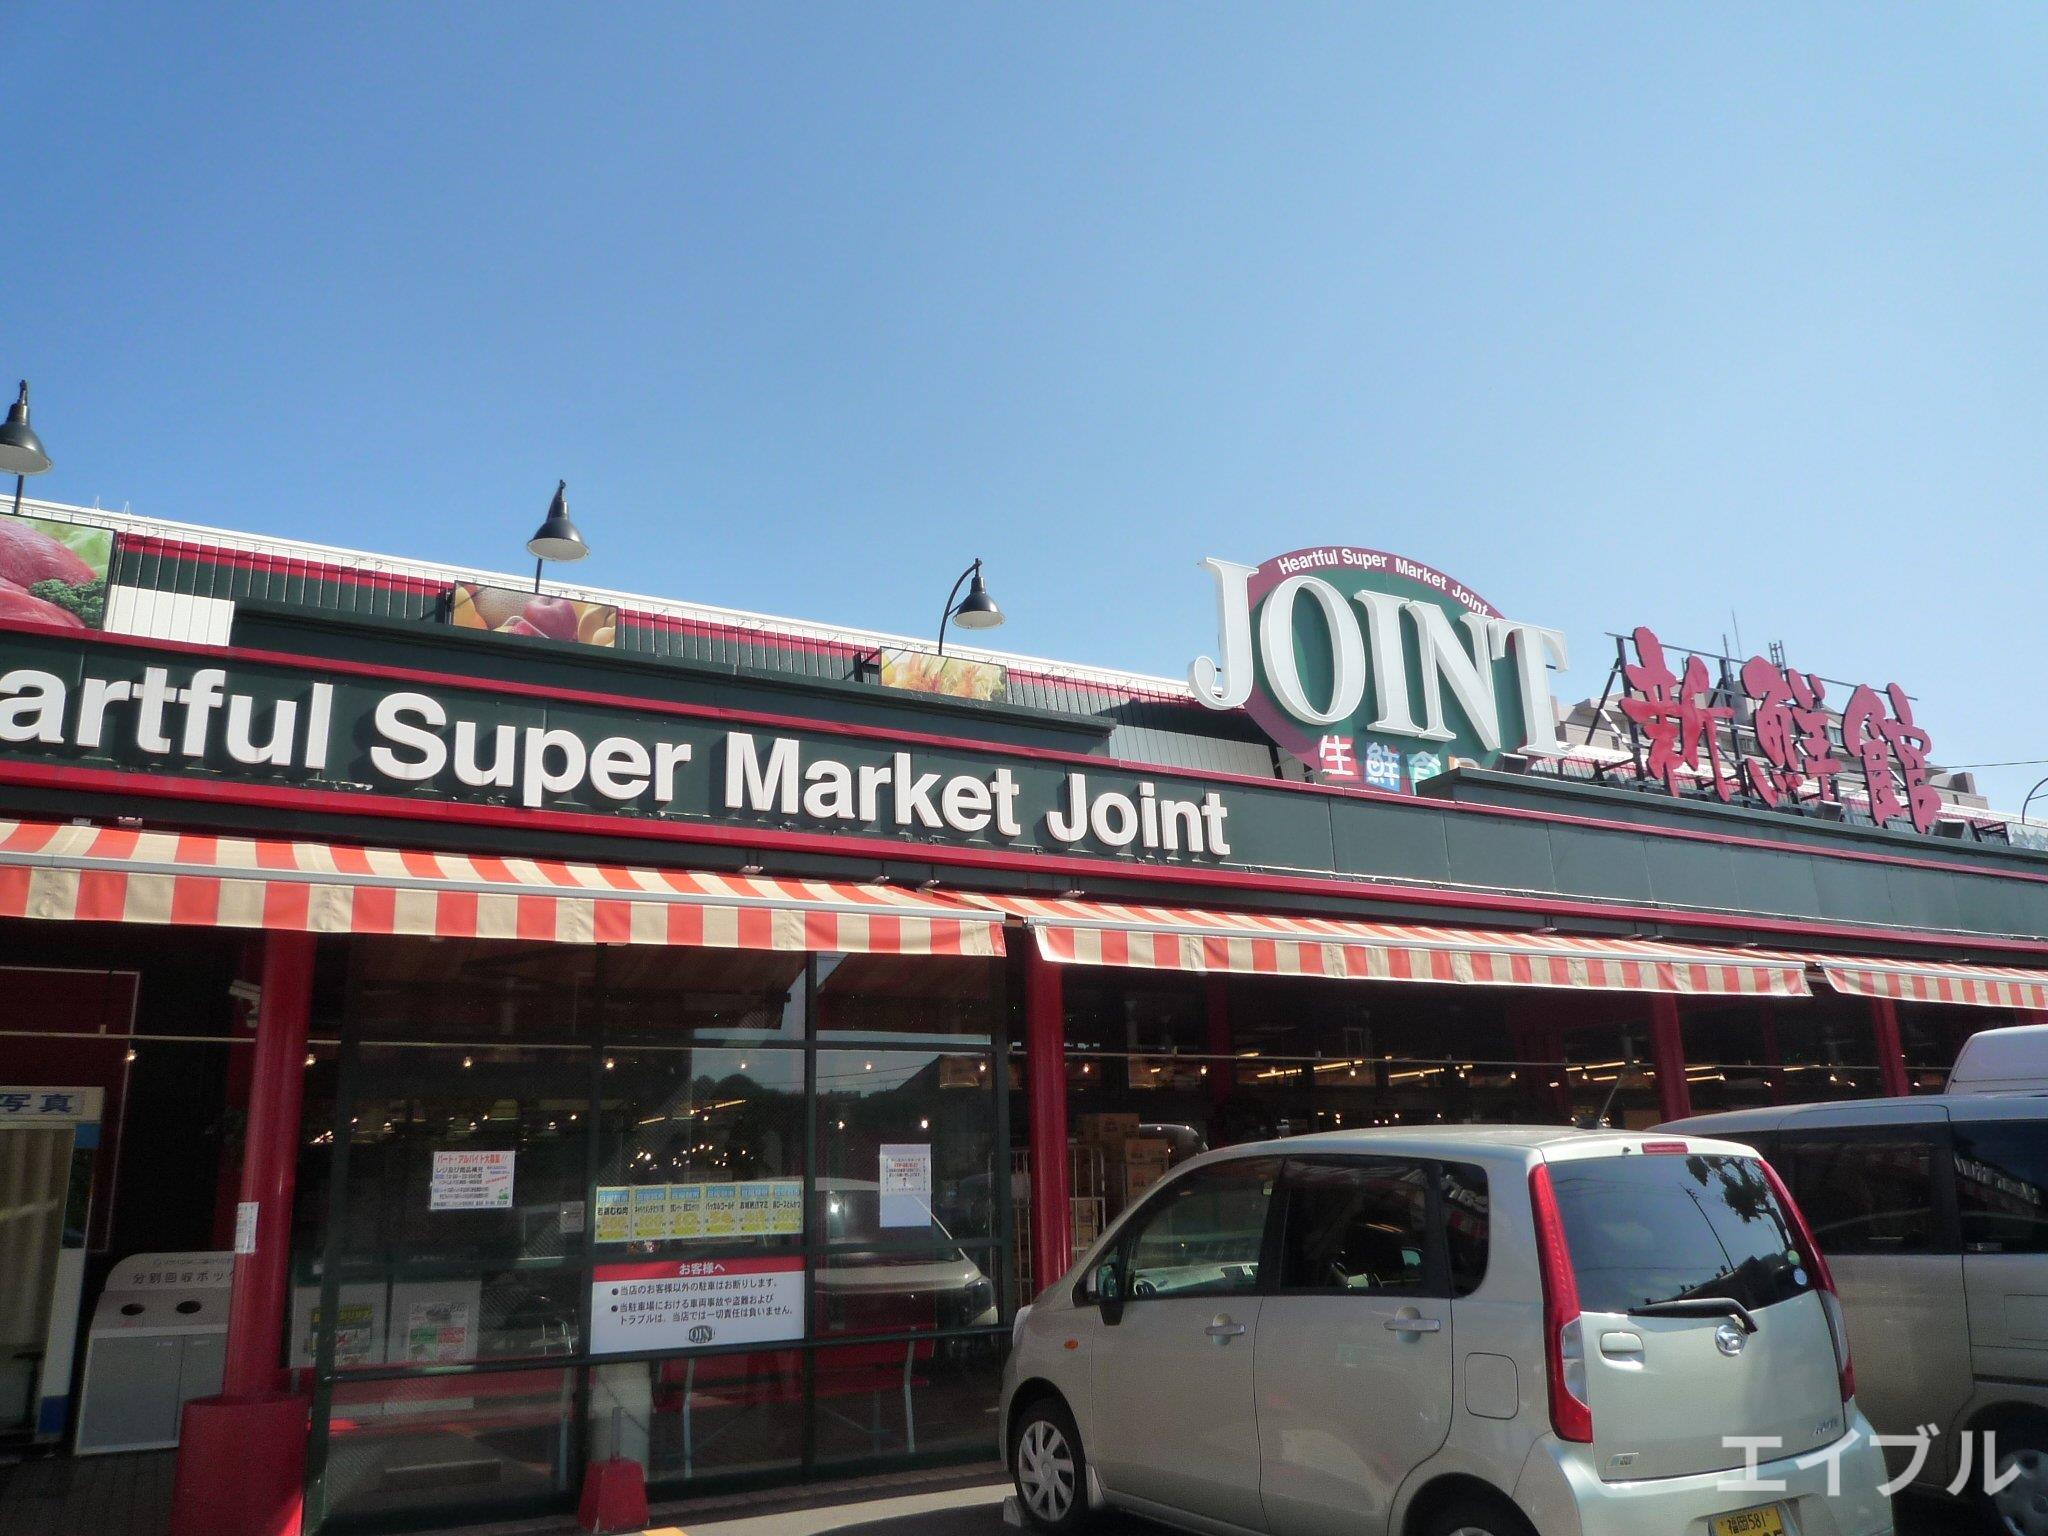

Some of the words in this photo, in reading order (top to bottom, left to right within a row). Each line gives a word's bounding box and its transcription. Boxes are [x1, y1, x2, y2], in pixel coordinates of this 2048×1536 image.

[1278, 549, 1339, 575] Heartful
[1341, 548, 1388, 570] Super
[1395, 557, 1447, 591] Market
[1452, 585, 1489, 617] Joint
[1187, 557, 1569, 758] JOINT
[371, 691, 691, 808] Super
[726, 731, 1021, 836] Market
[1046, 772, 1231, 856] Joint
[1318, 734, 1481, 796] 生鮮食
[620, 1278, 777, 1296] 当店のお客様以外の駐車はお断りします。
[679, 1262, 726, 1275] お客様へ
[620, 1294, 774, 1313] 当駐車場における車両事故や盗難および
